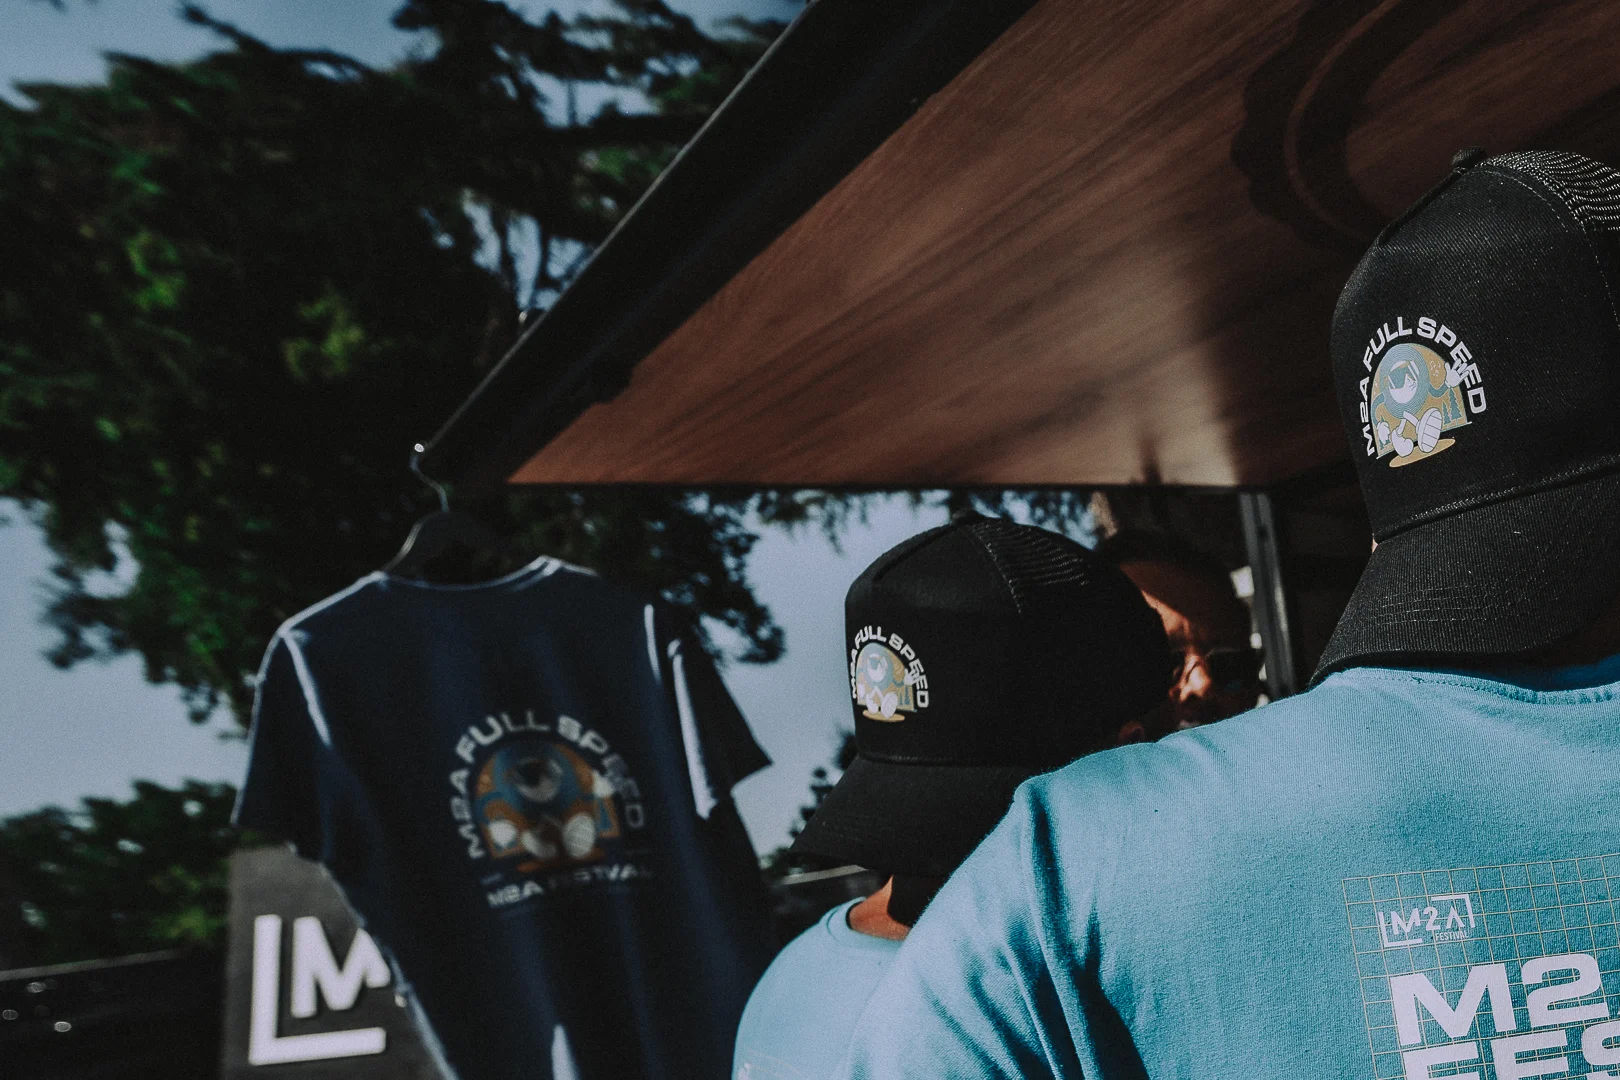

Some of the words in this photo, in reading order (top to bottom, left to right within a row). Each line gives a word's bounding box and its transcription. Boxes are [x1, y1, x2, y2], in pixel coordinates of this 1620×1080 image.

[1363, 316, 1412, 372] FULL
[1417, 316, 1486, 414] SPEED
[1360, 376, 1375, 456] M2A
[855, 625, 887, 650] FULL
[888, 633, 929, 708] SPEED
[454, 709, 551, 764] FULL
[1390, 905, 1465, 935] M2A
[1435, 930, 1470, 941] FESTIVAL
